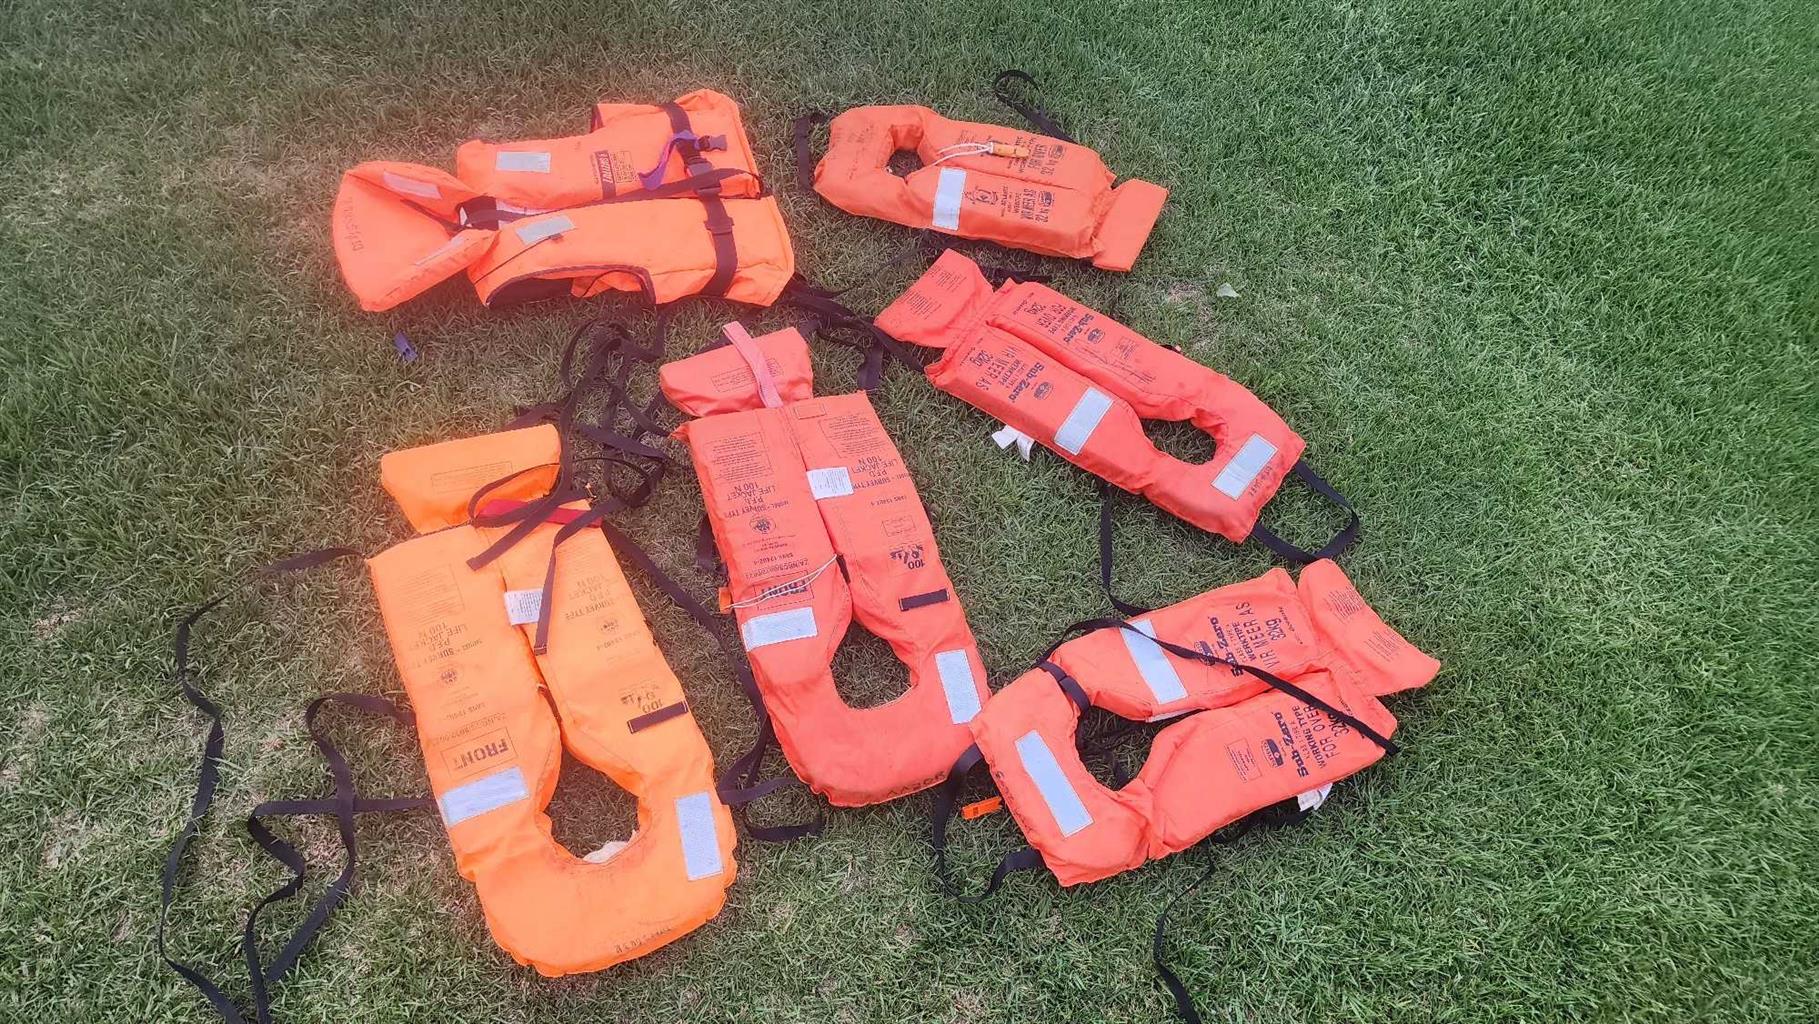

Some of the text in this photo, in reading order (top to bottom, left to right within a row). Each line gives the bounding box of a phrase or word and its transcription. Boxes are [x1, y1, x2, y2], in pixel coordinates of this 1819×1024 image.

[1062, 311, 1094, 343] Sub-Zero
[1007, 361, 1045, 402] Sub-Zero
[865, 454, 882, 464] 100
[725, 488, 757, 501] JACKET
[732, 481, 759, 493] 100 N
[906, 558, 925, 570] 100
[1230, 620, 1257, 661] WERKTIPE
[1233, 599, 1280, 669] VIR MEER AS
[641, 698, 663, 713] 100
[1271, 710, 1309, 778] Sub-Zero
[1290, 703, 1327, 768] WORKING TYPE
[1302, 702, 1340, 759] FOR OVER
[450, 736, 509, 771] FRONT
